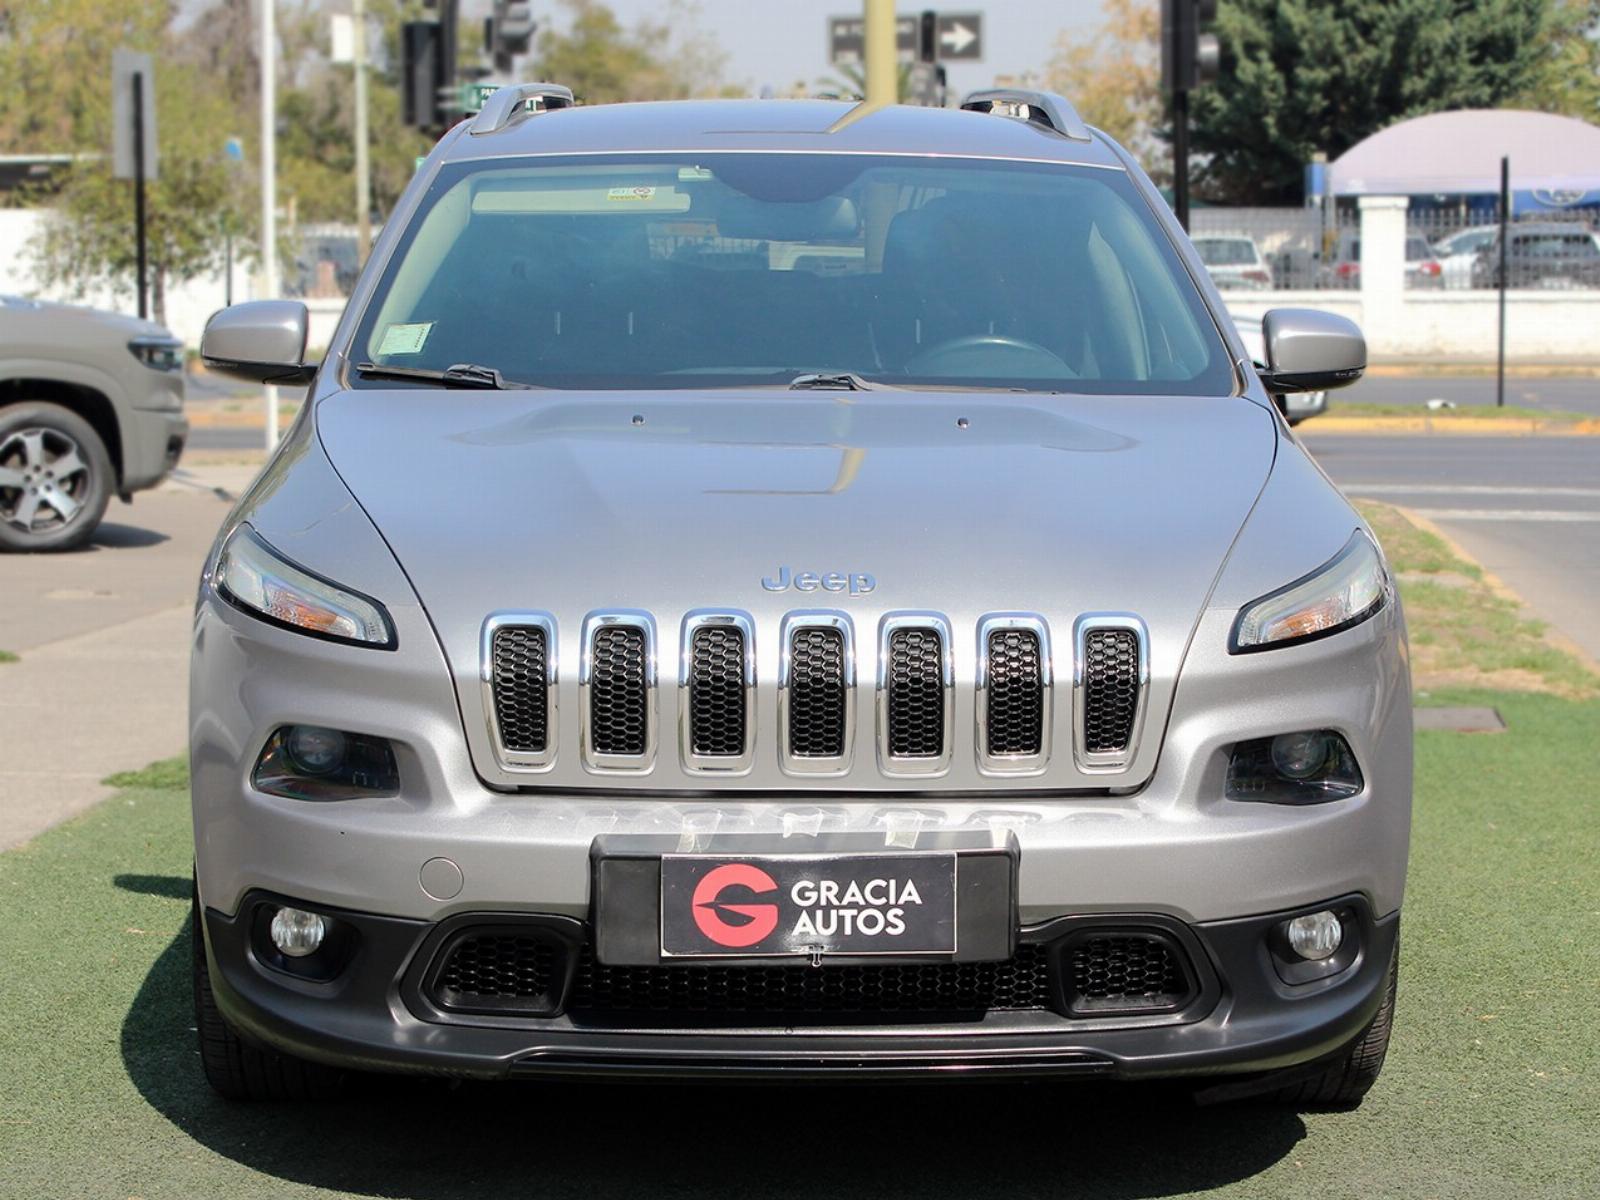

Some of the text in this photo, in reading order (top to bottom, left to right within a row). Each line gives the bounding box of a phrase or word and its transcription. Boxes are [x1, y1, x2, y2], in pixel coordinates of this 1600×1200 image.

[761, 566, 876, 597] Jeep
[790, 878, 922, 907] GRACIA
[791, 908, 906, 937] AUTOS
